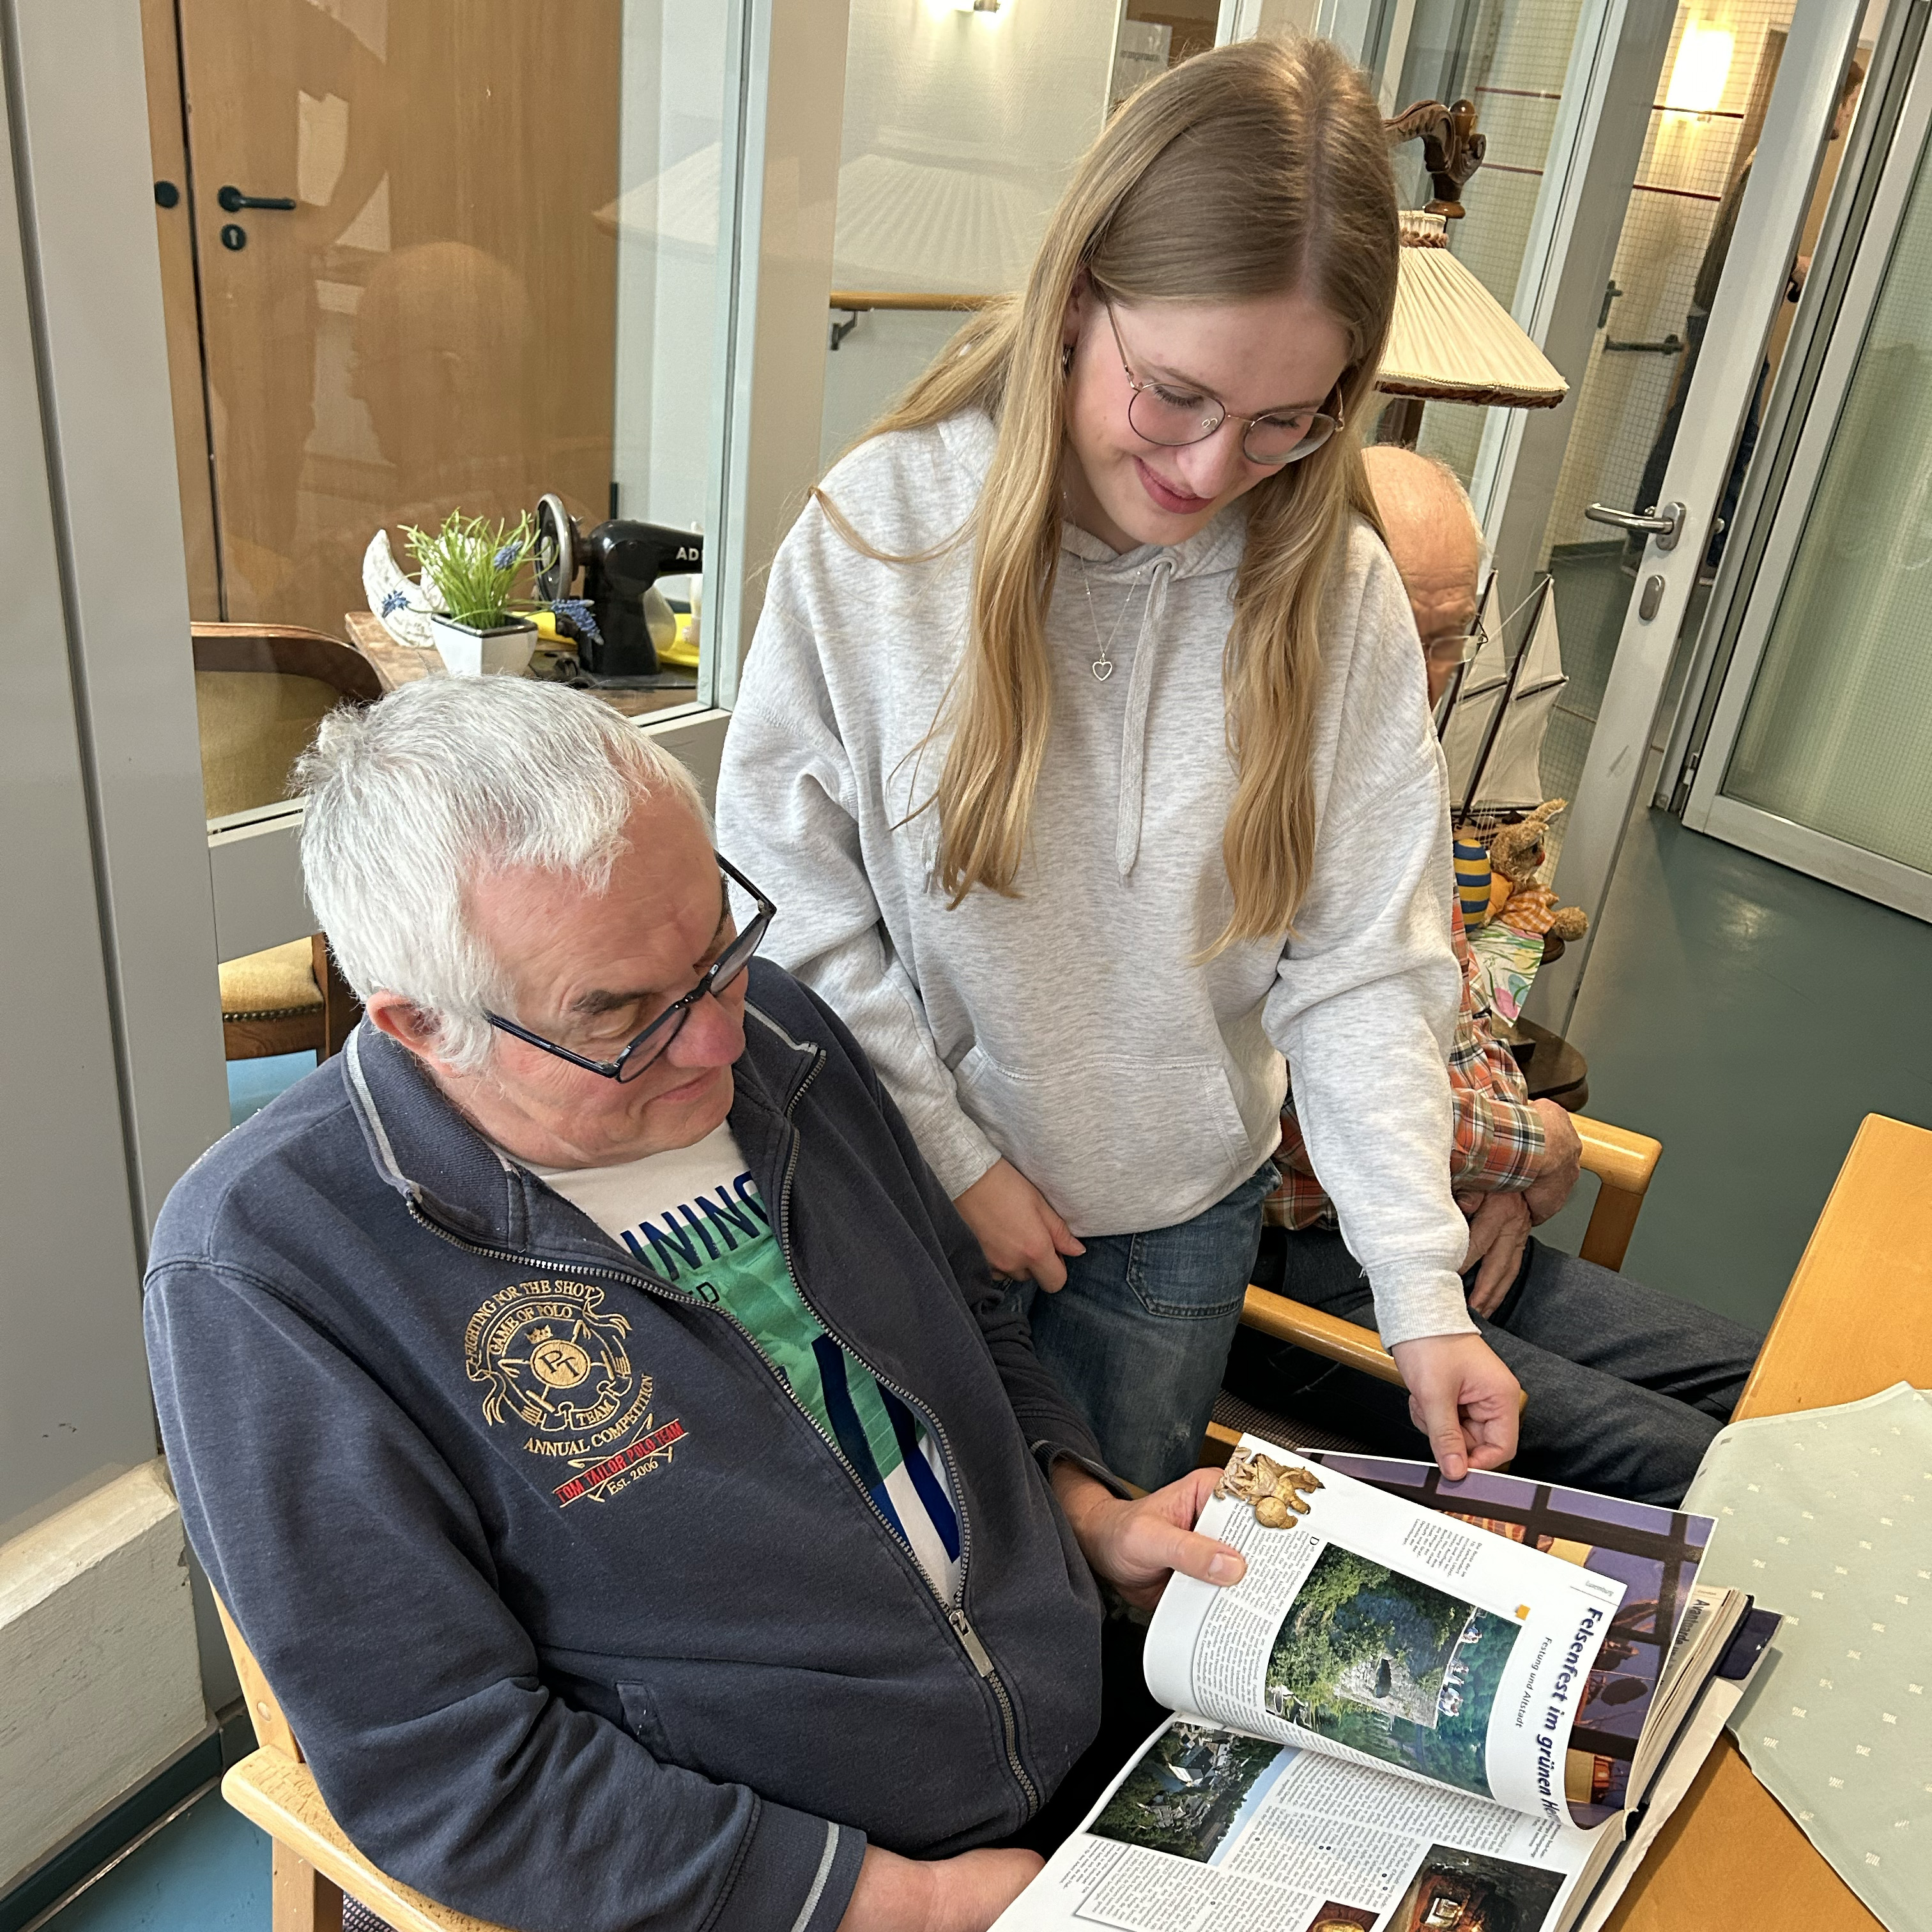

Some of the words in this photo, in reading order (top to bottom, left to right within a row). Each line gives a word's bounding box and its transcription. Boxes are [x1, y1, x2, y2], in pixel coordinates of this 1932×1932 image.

[675, 547, 703, 561] AD
[464, 1300, 497, 1357] FIGHTING
[493, 1286, 522, 1306] FOR
[520, 1280, 551, 1295] THE
[555, 1280, 595, 1300] SHOT
[490, 1317, 519, 1354] GAME
[516, 1307, 534, 1322] OF
[536, 1305, 572, 1318] POLO
[523, 1438, 590, 1456] ANNUAL
[591, 1373, 653, 1447] COMPETITION
[576, 1399, 615, 1426] TEAM
[555, 1480, 585, 1503] TOM
[584, 1455, 627, 1486] TAILOR
[626, 1438, 656, 1462] POLO
[654, 1421, 684, 1445] TEAM
[607, 1476, 631, 1496] Est.
[630, 1459, 659, 1480] 2006
[1531, 1637, 1552, 1670] Festung
[1552, 1607, 1603, 1702] Felsenfest
[1526, 1673, 1537, 1690] und
[1515, 1690, 1531, 1728] Altstadt
[1544, 1706, 1565, 1730] im
[1536, 1733, 1554, 1796] grünen
